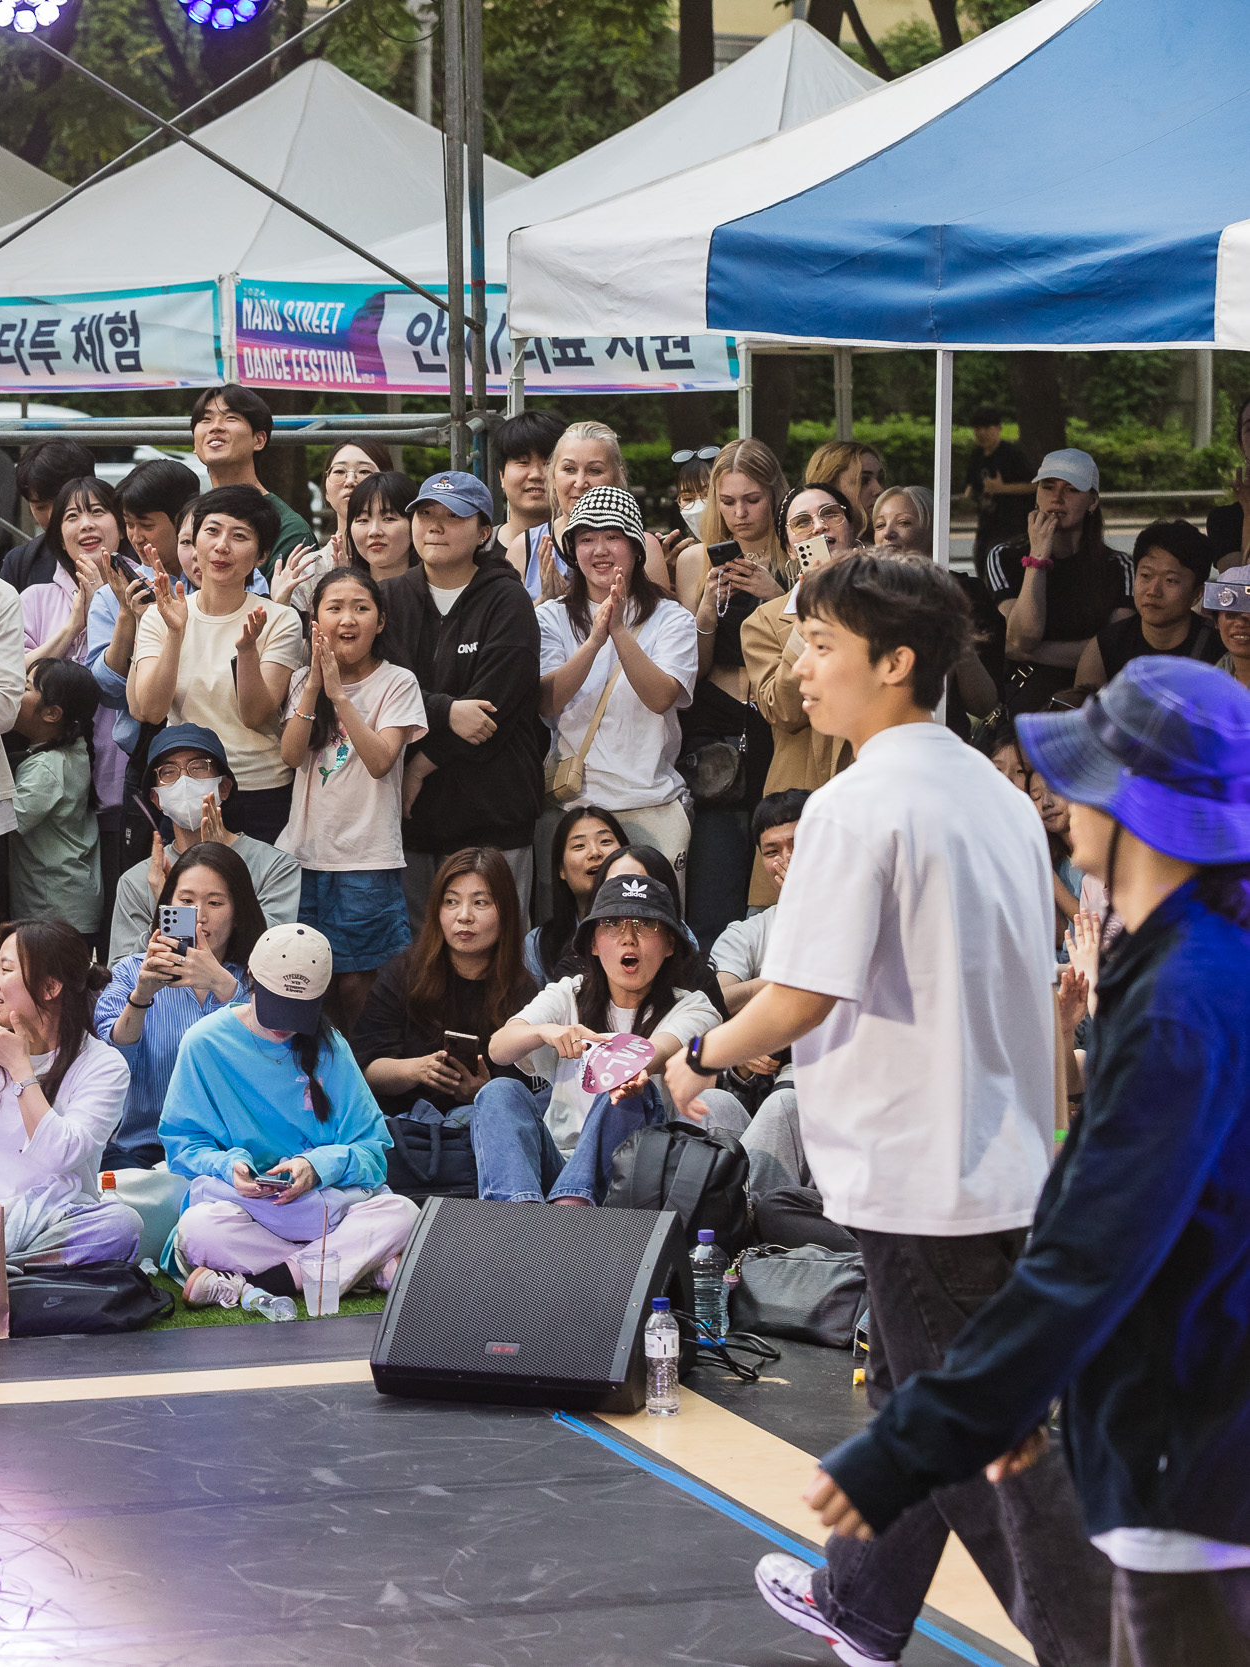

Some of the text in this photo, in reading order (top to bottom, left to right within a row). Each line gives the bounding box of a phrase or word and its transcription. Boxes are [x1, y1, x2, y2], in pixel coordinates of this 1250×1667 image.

[242, 297, 346, 335] NARU STREET
[70, 309, 144, 374] 체험
[242, 346, 292, 380] DANCE
[291, 348, 362, 384] FESTIVAL
[622, 890, 647, 899] adidas
[599, 1042, 651, 1087] HALO
